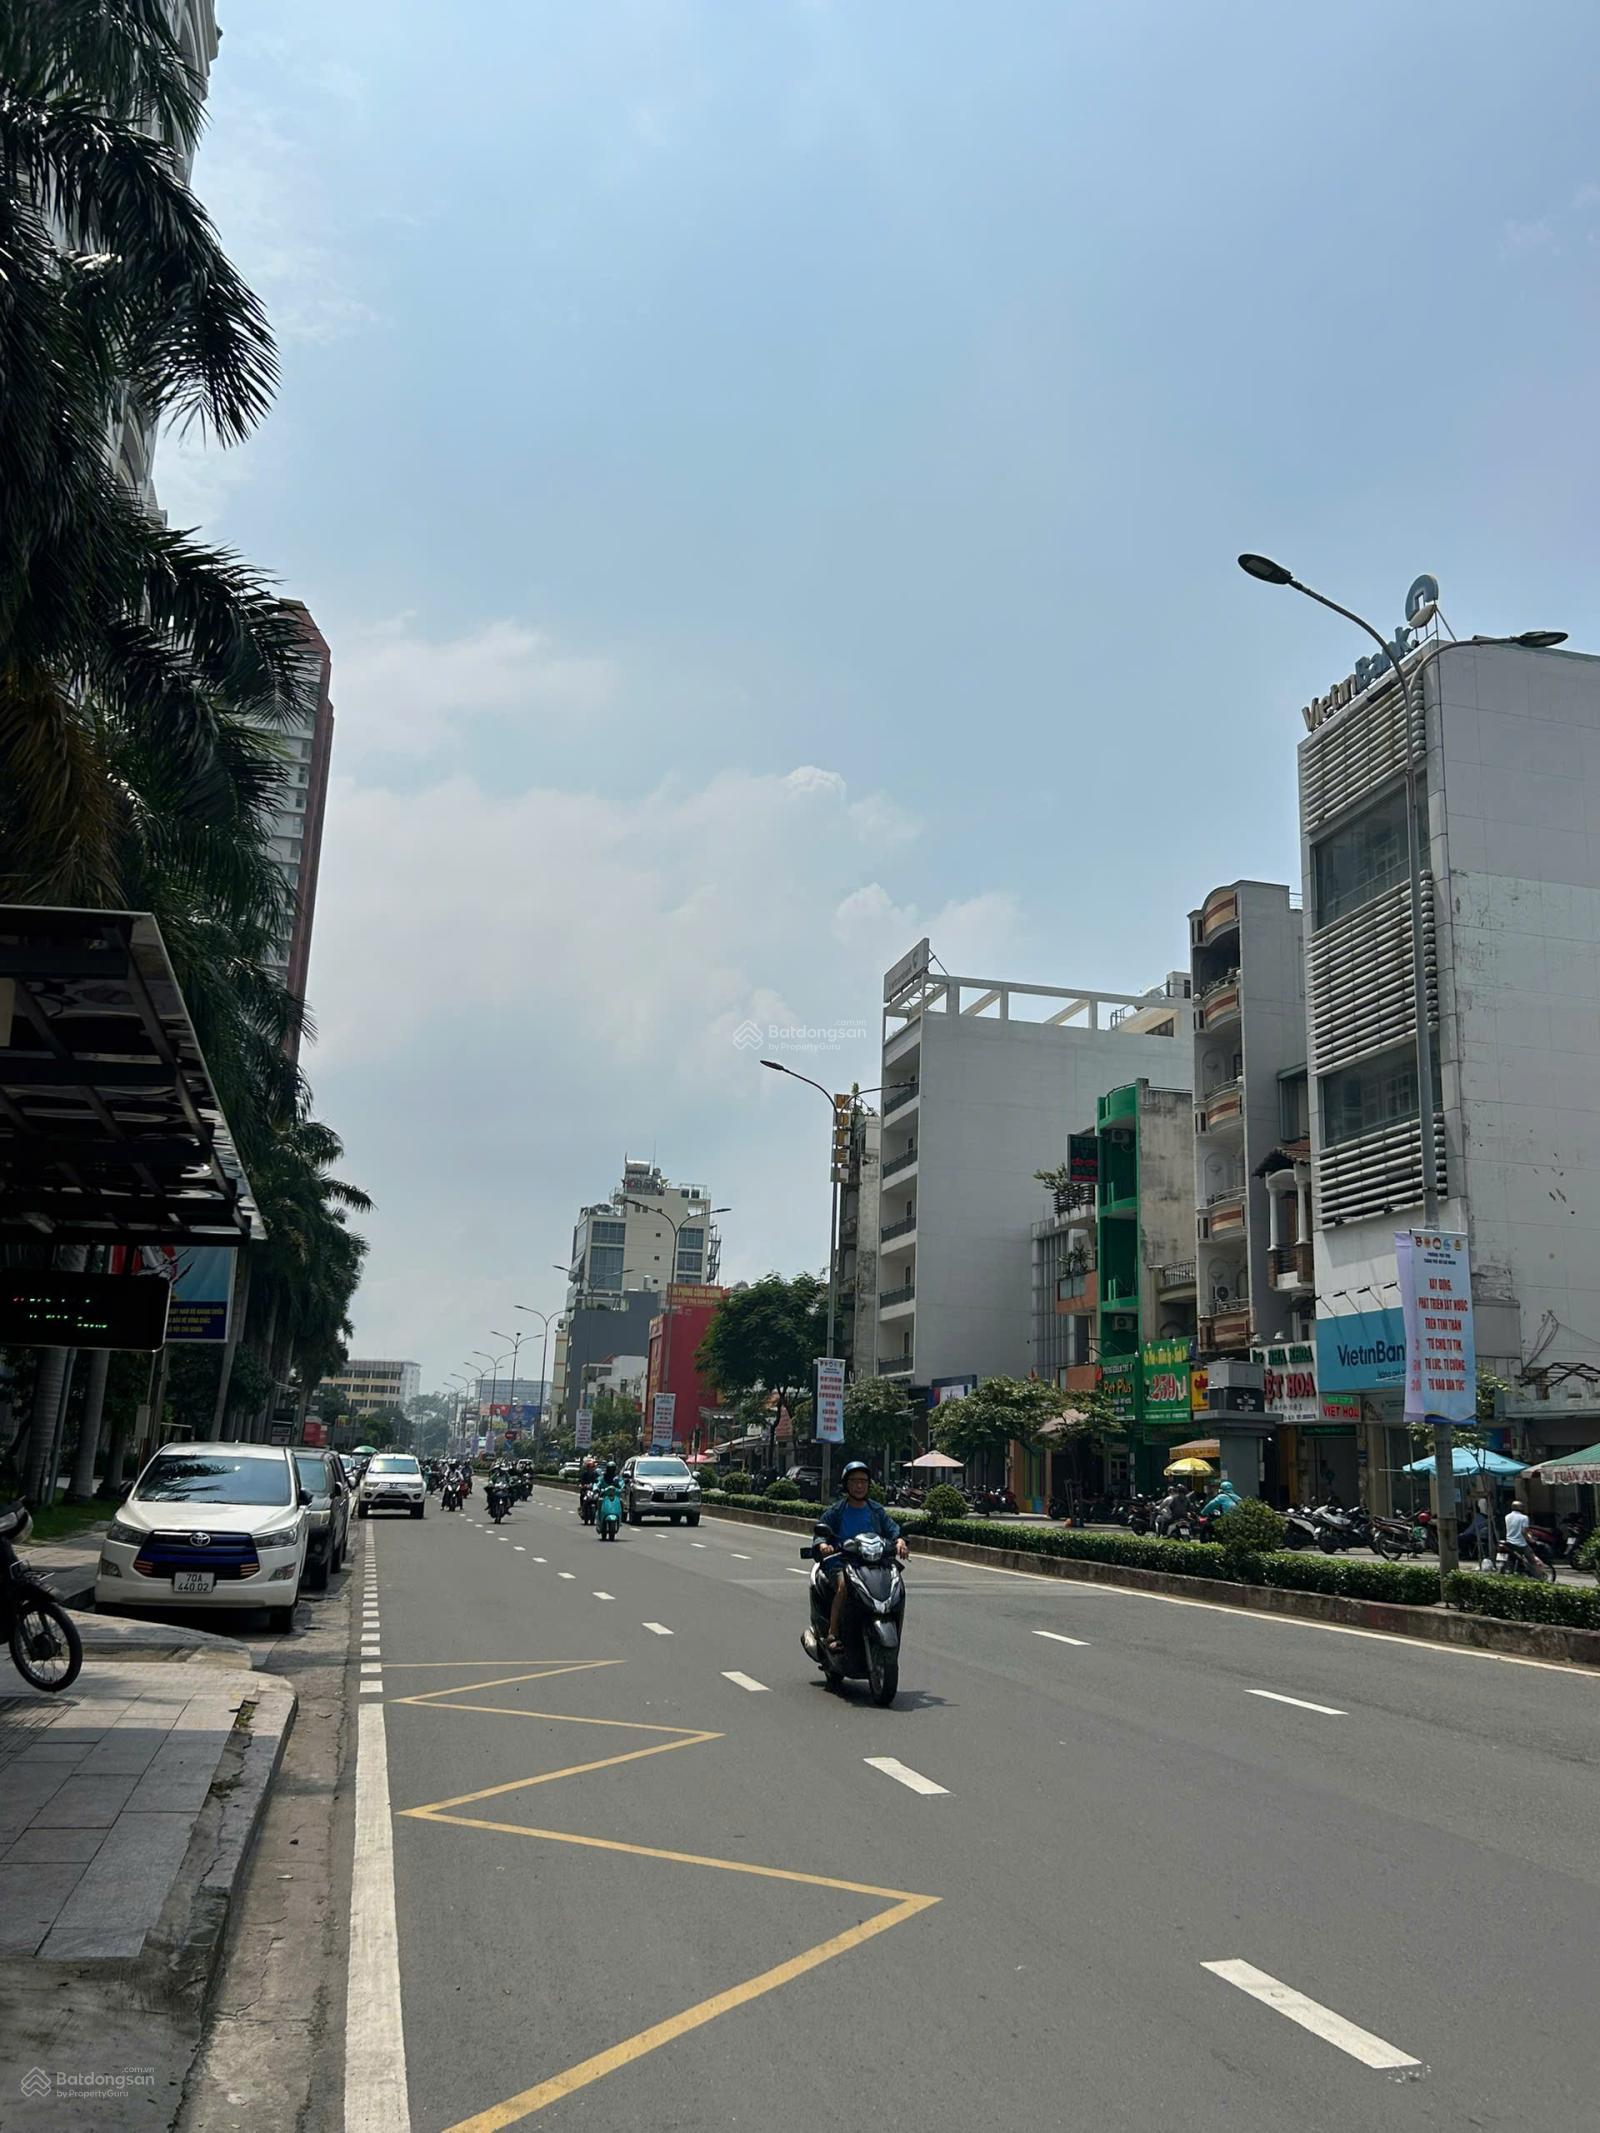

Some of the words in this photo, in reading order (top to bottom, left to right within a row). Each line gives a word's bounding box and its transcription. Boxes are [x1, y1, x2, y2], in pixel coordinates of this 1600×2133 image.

[1289, 1345, 1314, 1364] KHOA
[1337, 1339, 1406, 1367] VietinBan
[1286, 1372, 1316, 1398] HOA
[186, 1573, 202, 1583] 70A
